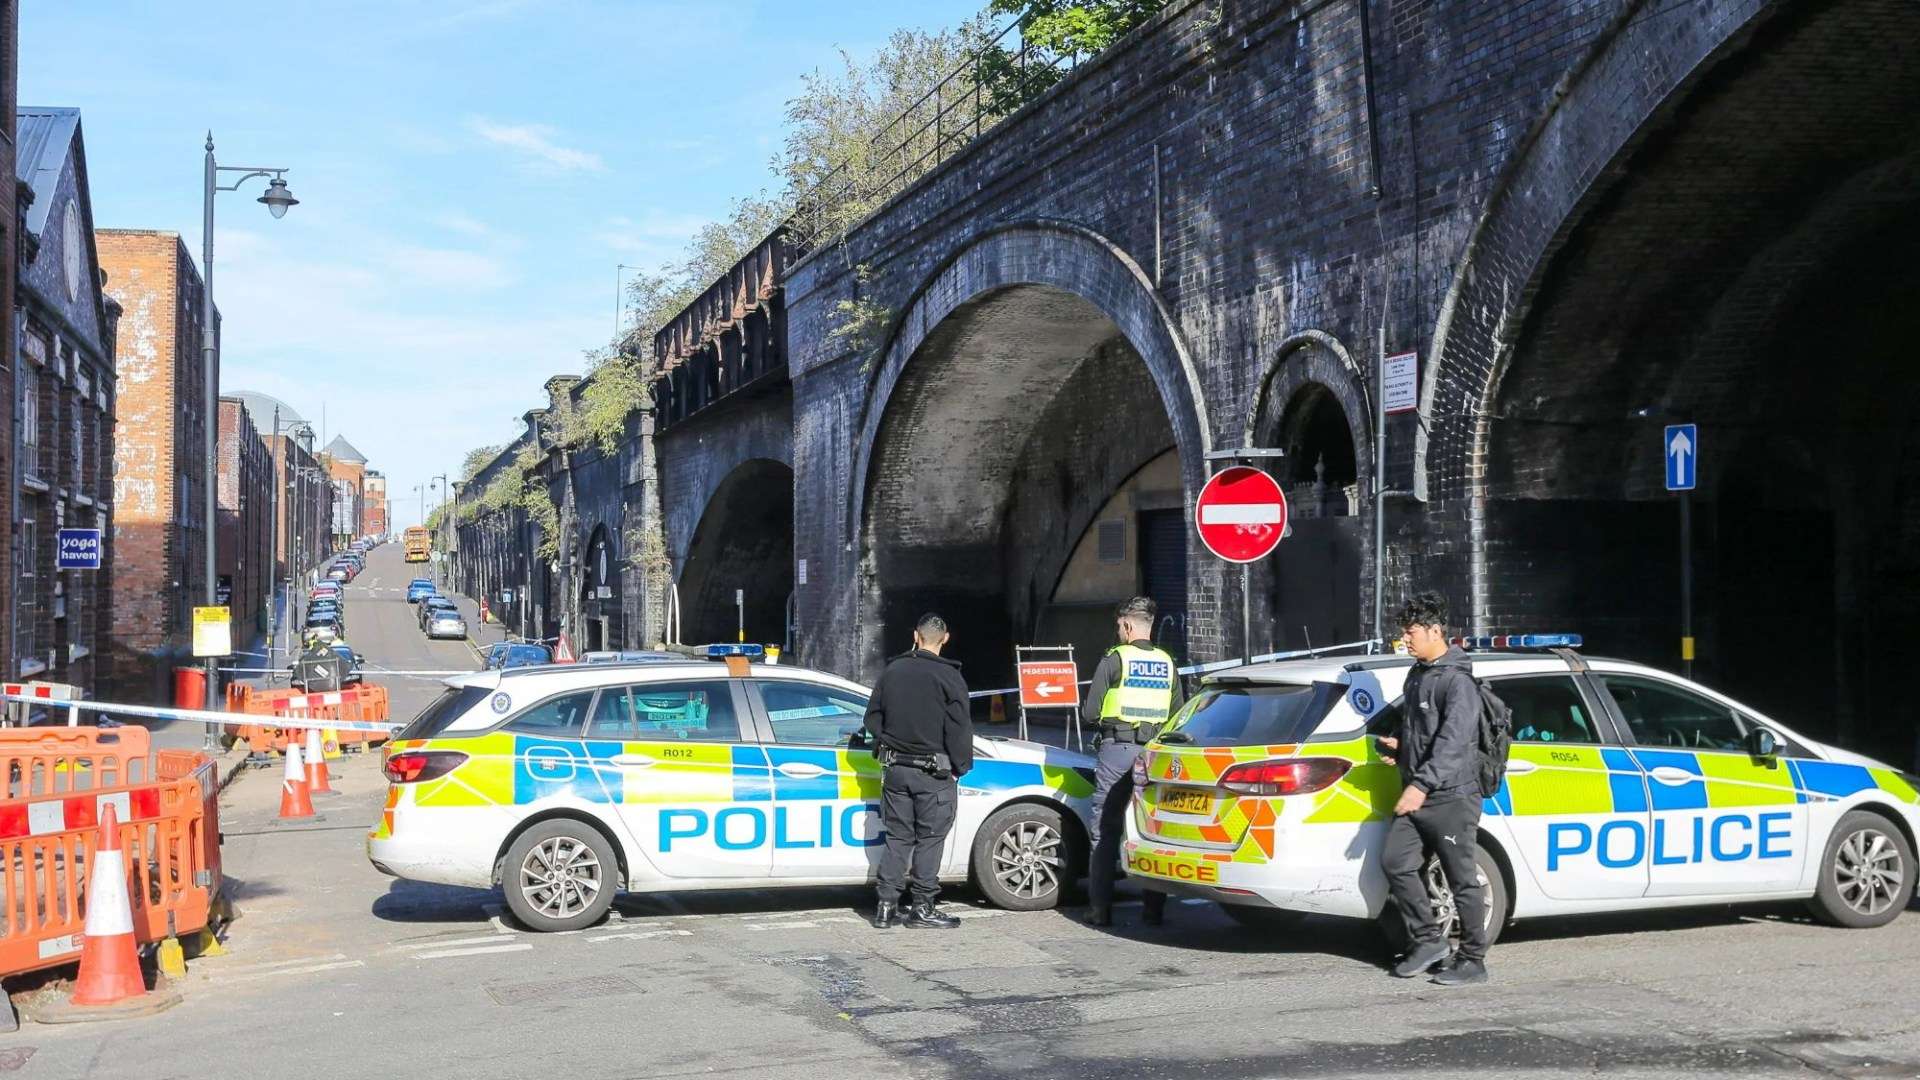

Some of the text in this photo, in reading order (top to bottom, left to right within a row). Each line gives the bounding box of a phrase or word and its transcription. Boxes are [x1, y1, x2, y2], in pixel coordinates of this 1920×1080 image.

[62, 539, 97, 550] yoga
[62, 551, 97, 559] haven
[1022, 667, 1073, 675] PEDESTRIANS
[1130, 662, 1168, 676] POLICE
[663, 749, 693, 757] R012
[1550, 751, 1581, 762] R054
[1187, 793, 1209, 812] RZA
[658, 803, 887, 852] POLIC
[1547, 812, 1793, 872] POLICE
[1128, 857, 1216, 882] POLICE
